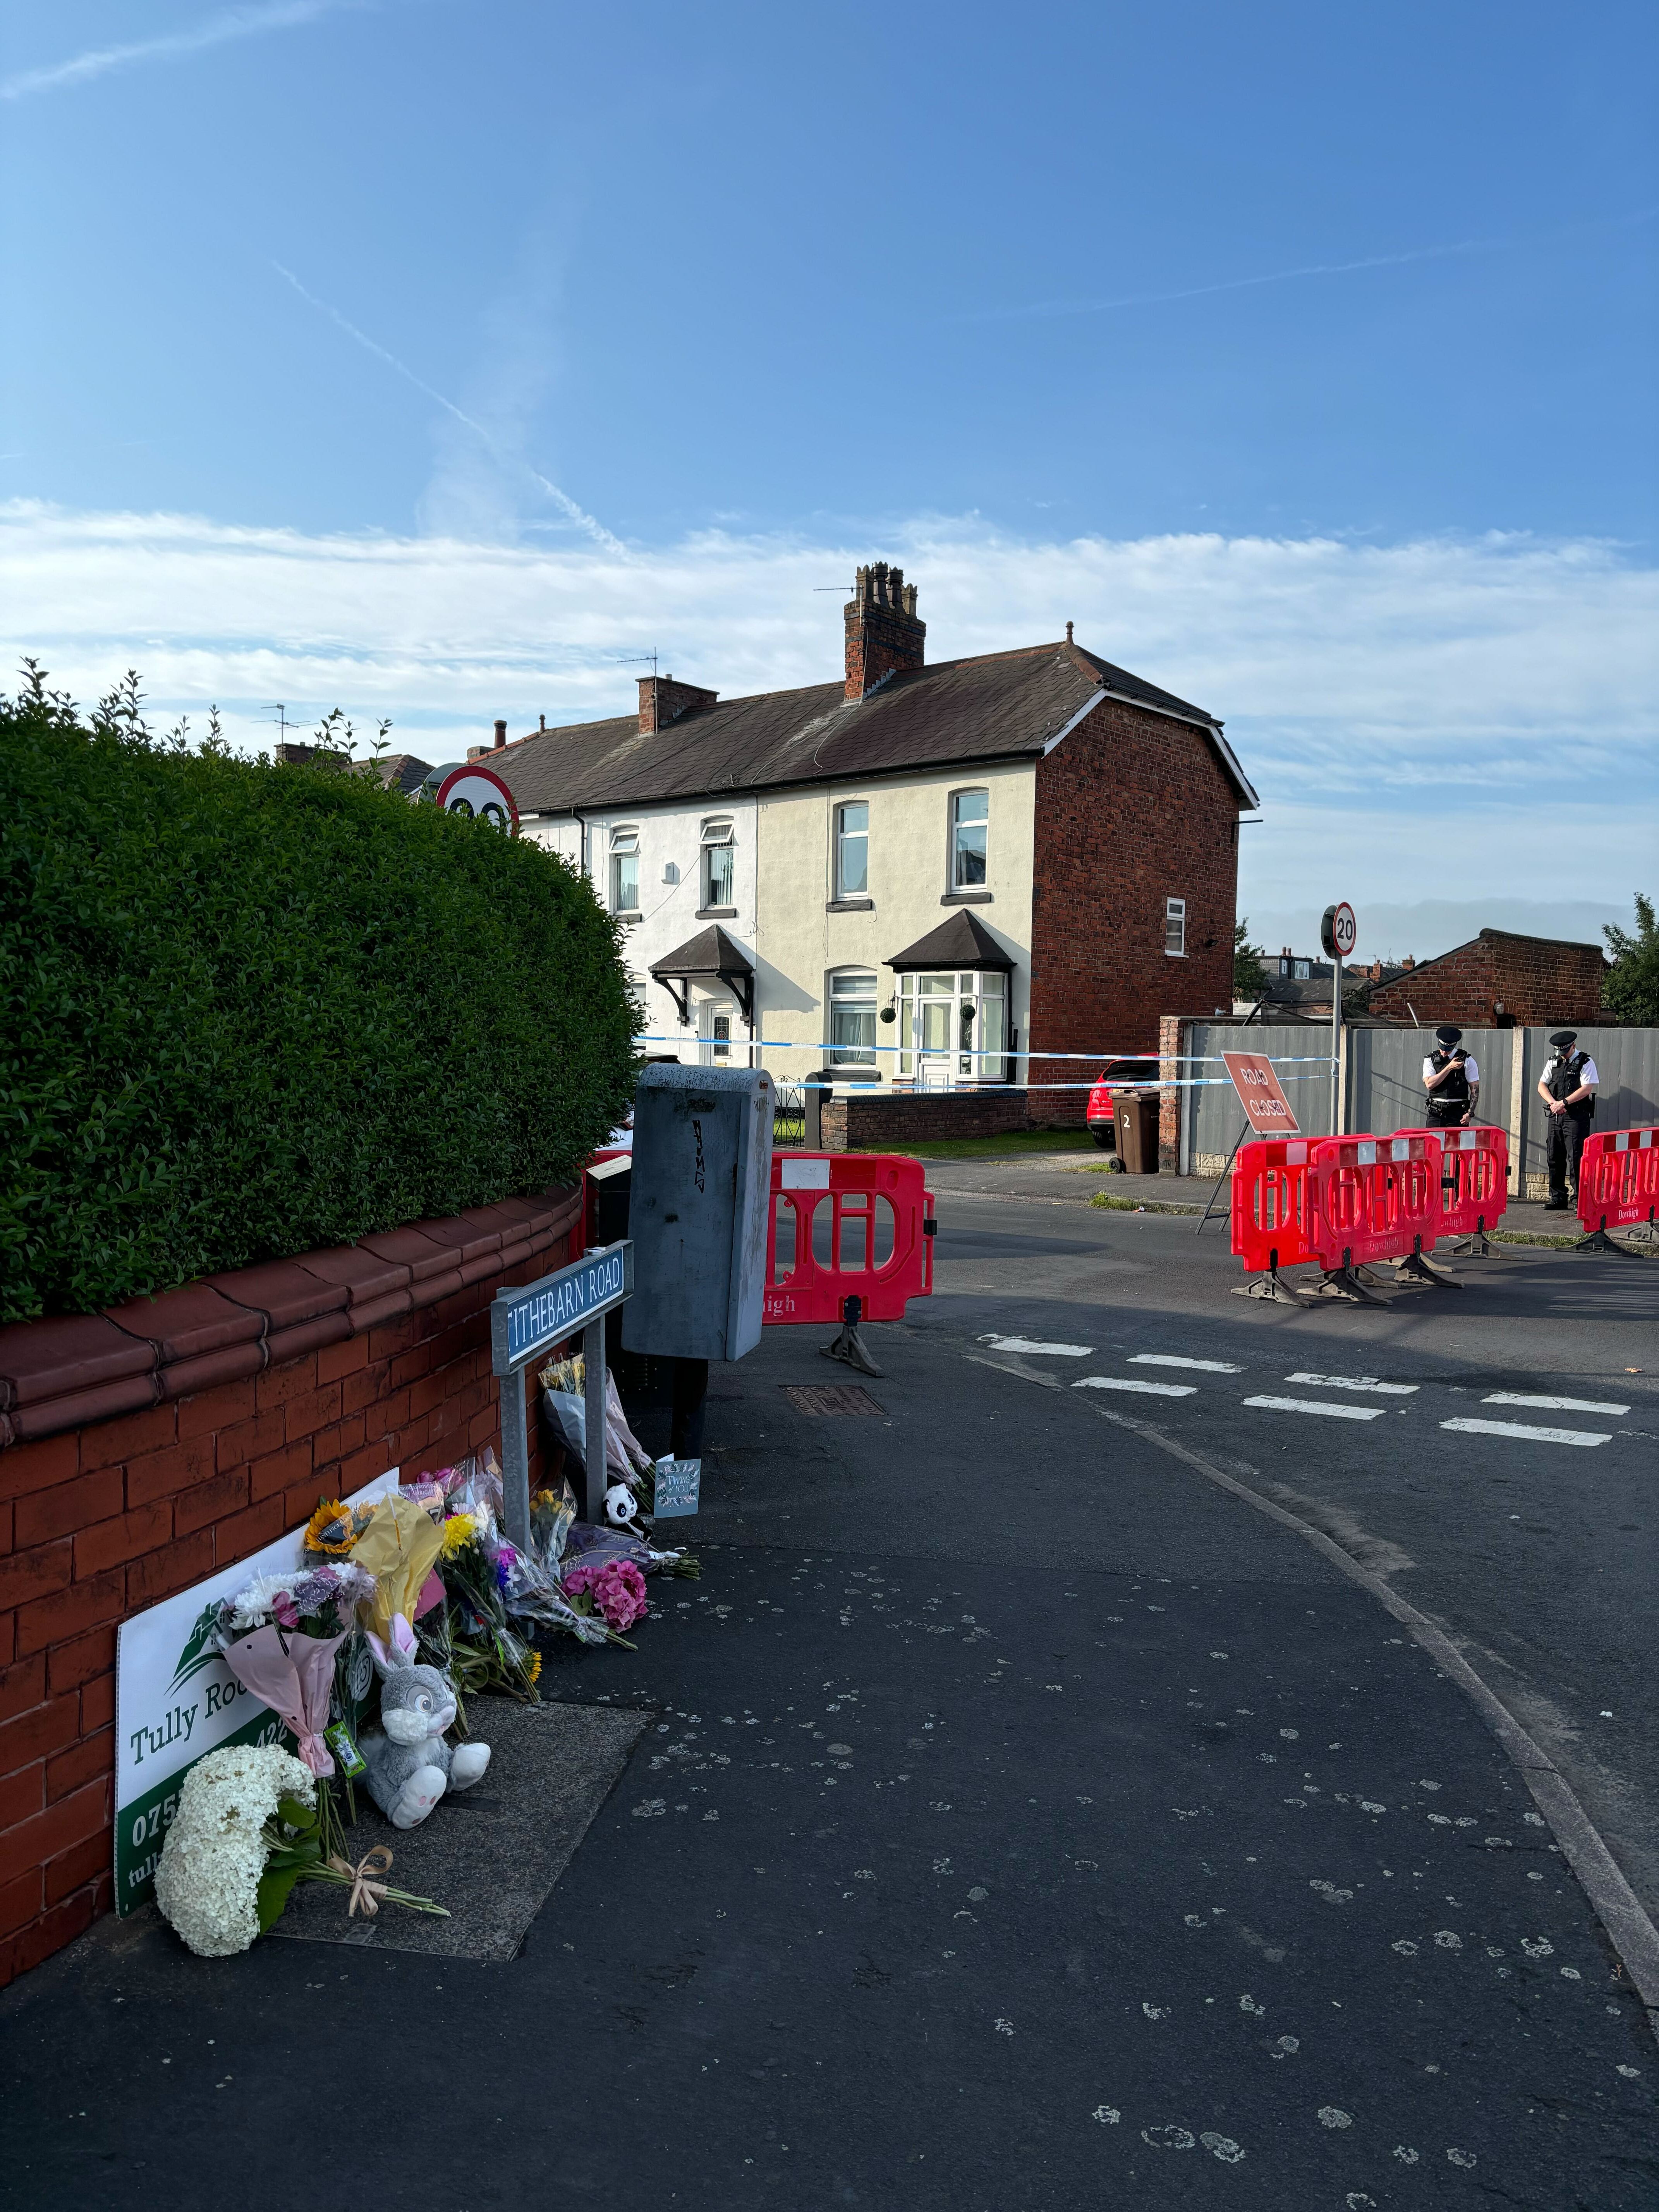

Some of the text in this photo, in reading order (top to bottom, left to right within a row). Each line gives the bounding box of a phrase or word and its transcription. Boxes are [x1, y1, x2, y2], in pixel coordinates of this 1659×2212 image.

[1337, 917, 1353, 940] 20
[1240, 1068, 1268, 1085] ROAD
[1250, 1099, 1286, 1116] CLOSED
[1124, 1115, 1130, 1128] 2
[1618, 1206, 1639, 1220] Dowhigh
[1441, 1216, 1463, 1230] whigh
[589, 1257, 620, 1303] ROAD
[666, 1475, 690, 1485] THINKING
[675, 1485, 689, 1493] YOU
[316, 1531, 330, 1542] HAND
[131, 1704, 198, 1765] Tully
[133, 1787, 184, 1846] 075
[128, 1851, 162, 1887] tull
